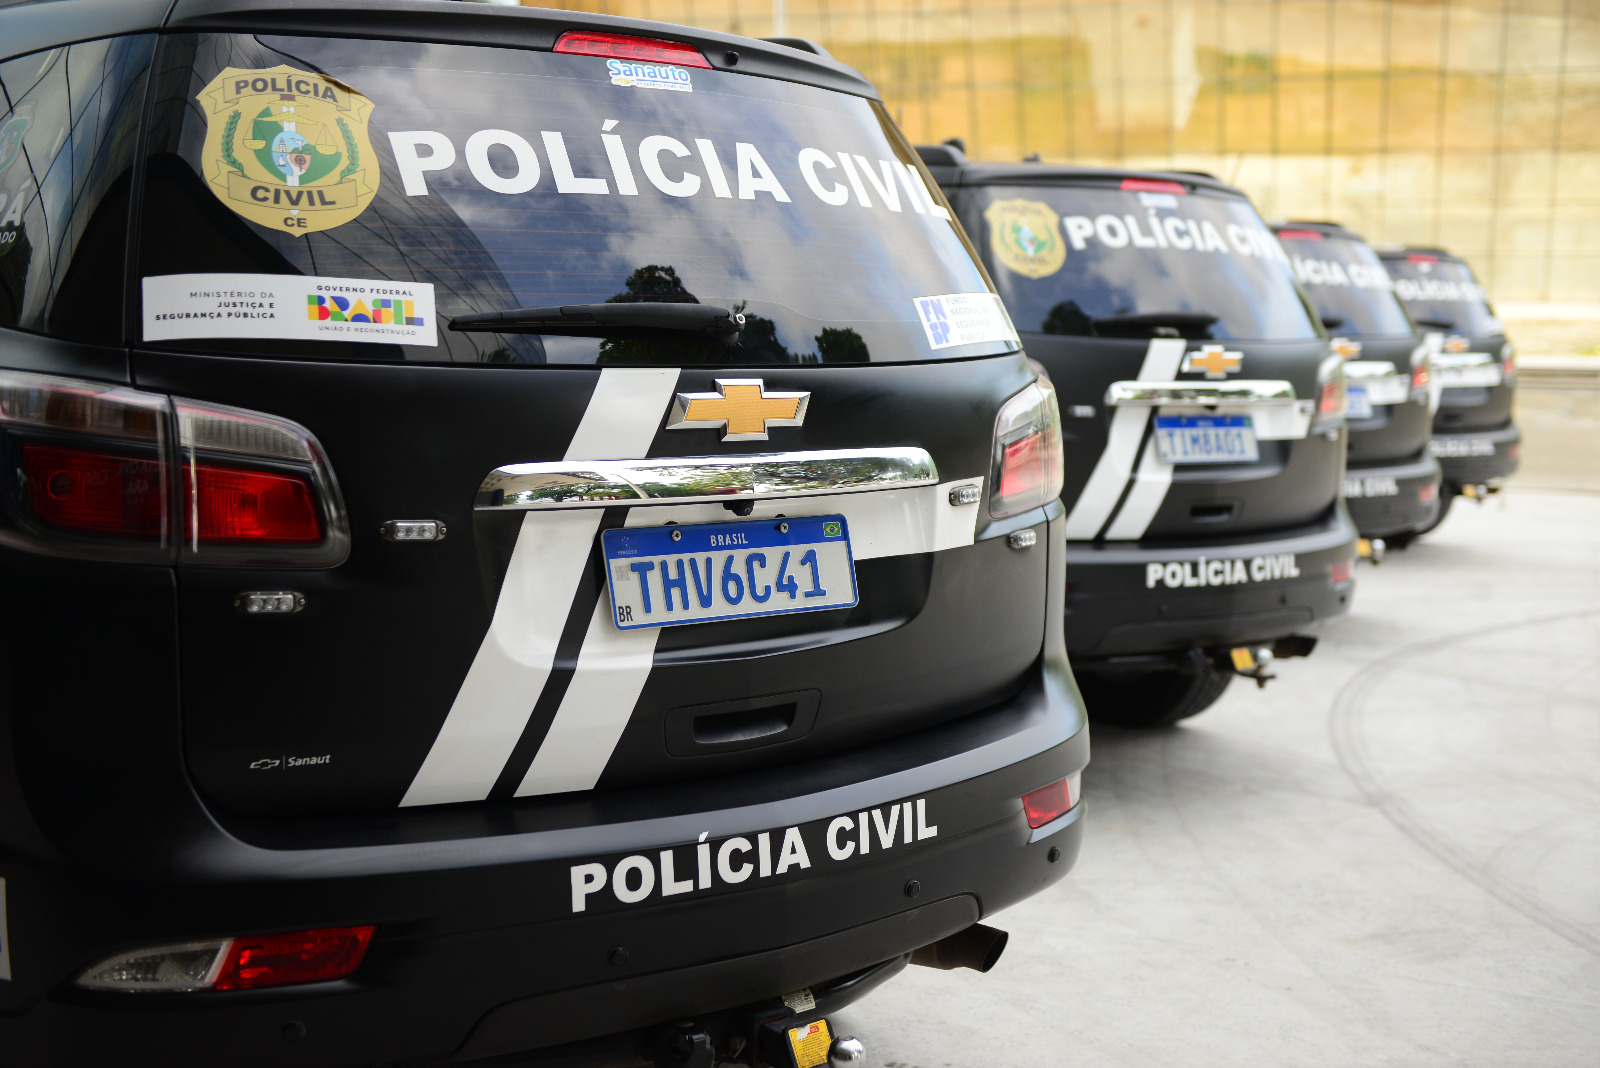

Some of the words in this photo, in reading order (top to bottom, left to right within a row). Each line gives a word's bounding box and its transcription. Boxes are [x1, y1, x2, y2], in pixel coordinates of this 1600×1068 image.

[608, 60, 689, 82] Sanauto
[235, 75, 338, 103] POLÍCIA
[387, 119, 793, 203] POLÍCIA
[798, 147, 952, 222] CIVIL
[250, 185, 337, 207] CIVIL
[283, 216, 308, 228] CE
[1062, 208, 1230, 254] POLÍCIA
[189, 290, 256, 299] MINISTÉRIO
[260, 291, 275, 299] DA
[316, 285, 367, 294] GOVERNO
[370, 288, 415, 297] FEDERAL
[945, 296, 968, 305] FUNDO
[155, 310, 224, 321] SEGURANÇA
[227, 309, 276, 319] PÚBLICA
[217, 301, 266, 311] JUSTIÇA
[268, 301, 275, 309] E
[307, 294, 425, 327] BRASIL
[920, 298, 948, 323] FN
[318, 324, 345, 333] UNIÃO
[355, 327, 417, 337] RECONSTRUÇÃO
[709, 533, 749, 547] BRASIL
[630, 548, 827, 614] THV6C41
[1146, 555, 1249, 589] POLÍCIA
[1250, 554, 1300, 581] CIVIL
[617, 605, 634, 623] BR
[287, 755, 331, 766] Sanaut
[570, 827, 811, 913] POLÍCIA
[826, 798, 938, 862] CIVIL
